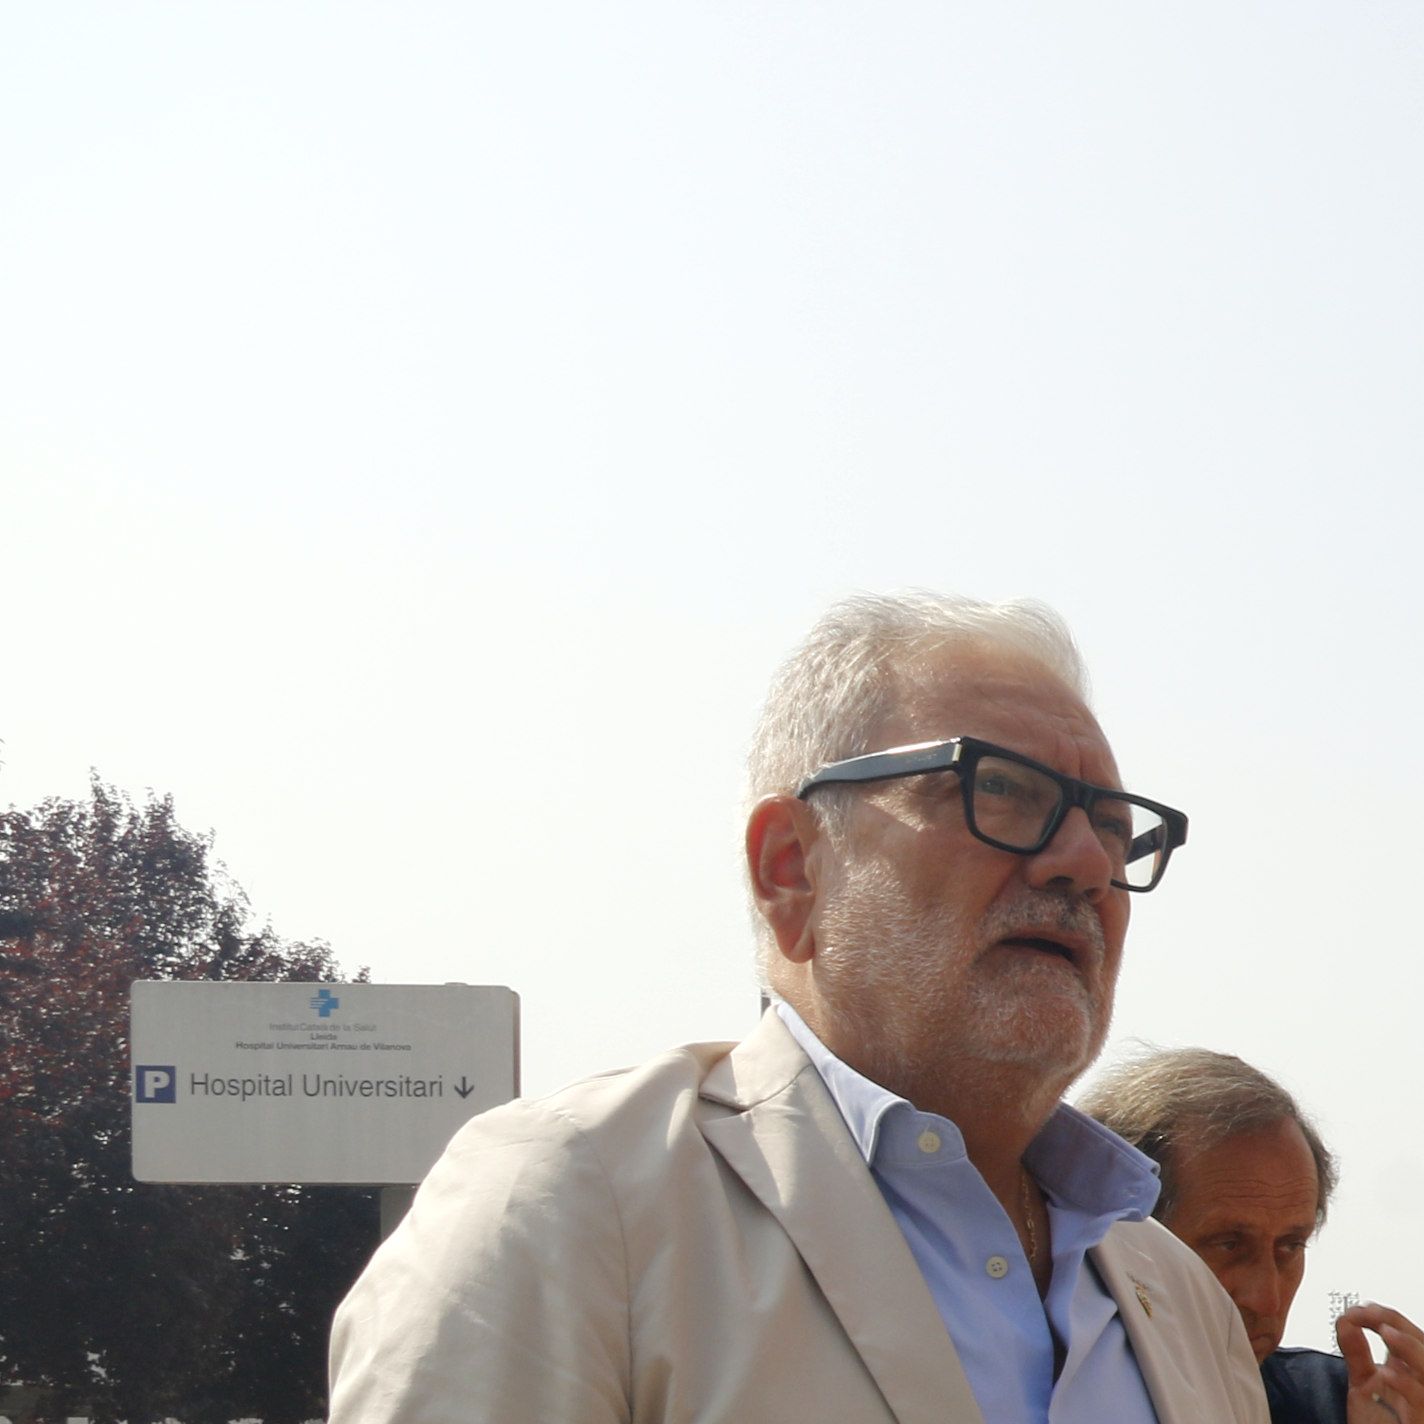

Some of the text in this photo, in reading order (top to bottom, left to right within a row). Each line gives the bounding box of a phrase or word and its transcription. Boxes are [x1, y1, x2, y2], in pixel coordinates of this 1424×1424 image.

[235, 1041, 412, 1051] Hospital Universitari Arnau de Vilanova
[144, 1070, 443, 1101] P Hospital Universitari
